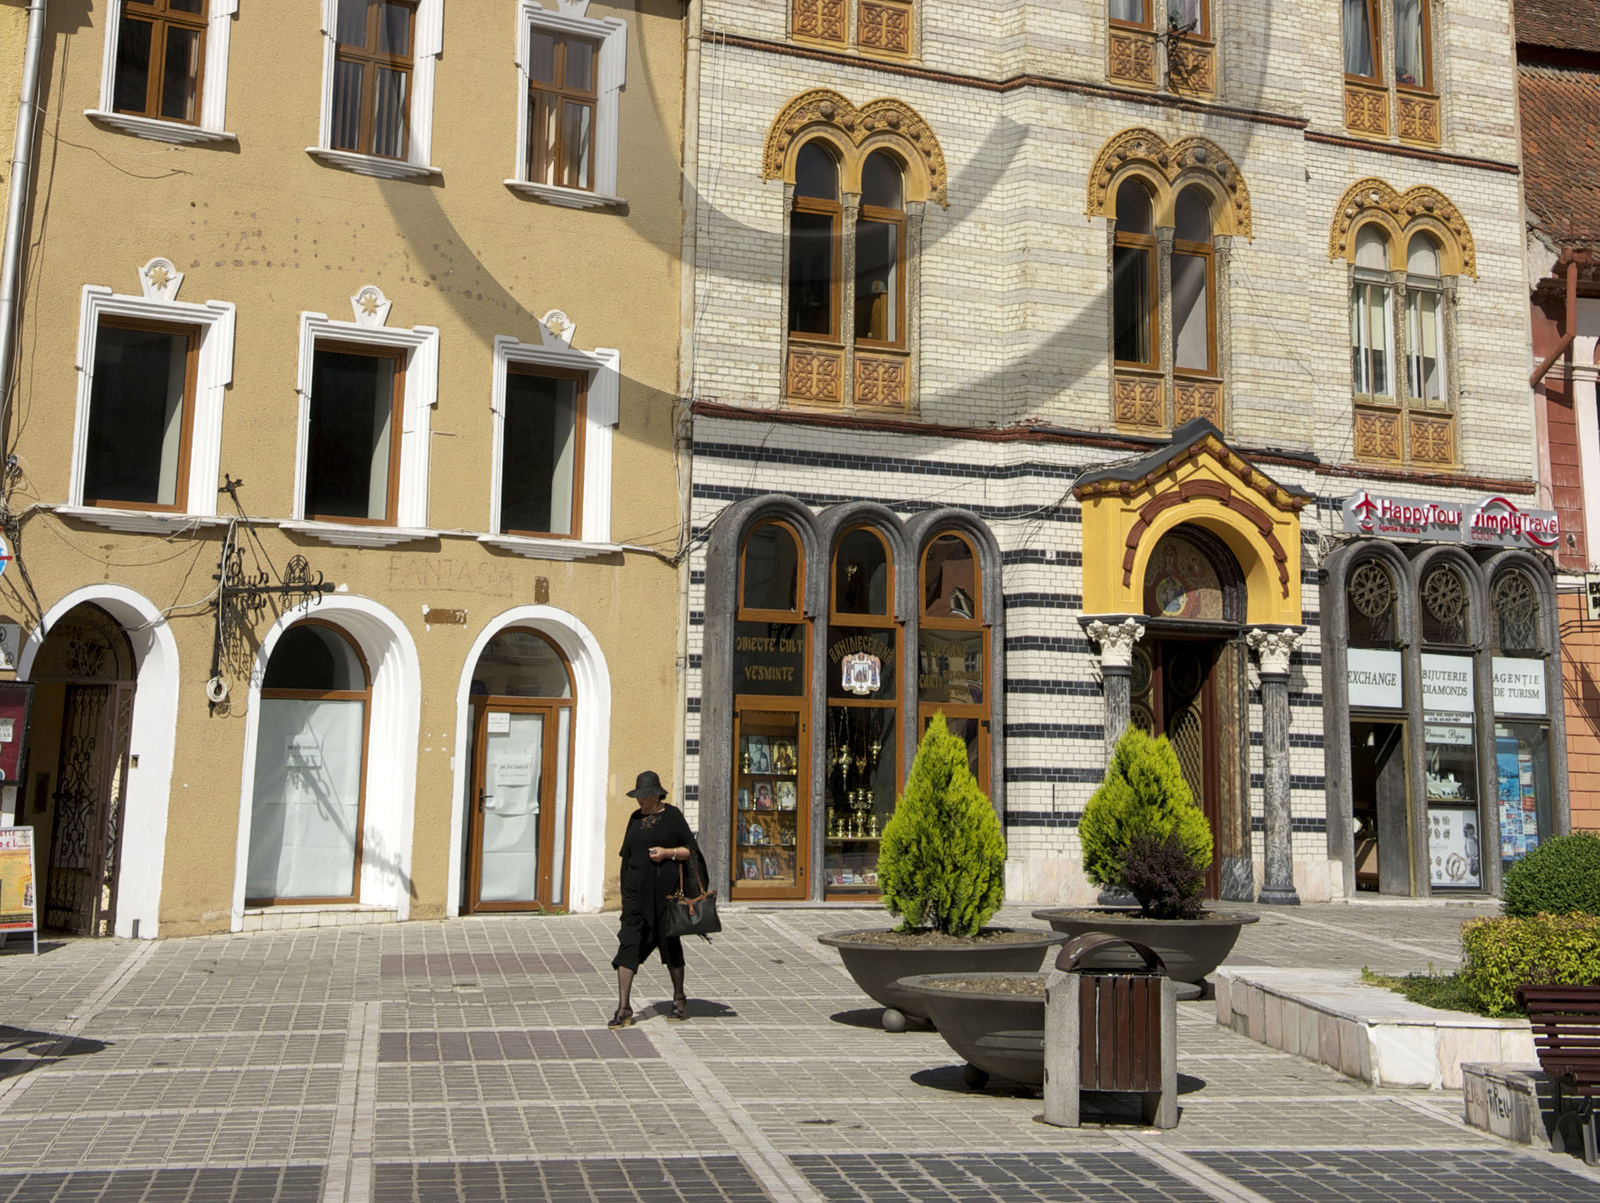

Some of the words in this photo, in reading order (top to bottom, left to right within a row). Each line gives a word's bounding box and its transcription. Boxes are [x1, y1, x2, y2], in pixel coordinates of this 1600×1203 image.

[779, 638, 803, 653] CULT
[1347, 671, 1397, 686] EXCHANGE
[1422, 670, 1468, 682] BIJUTERIE
[1423, 685, 1468, 696] DIAMONDS
[1494, 687, 1505, 697] DE
[1508, 688, 1540, 699] TURISM
